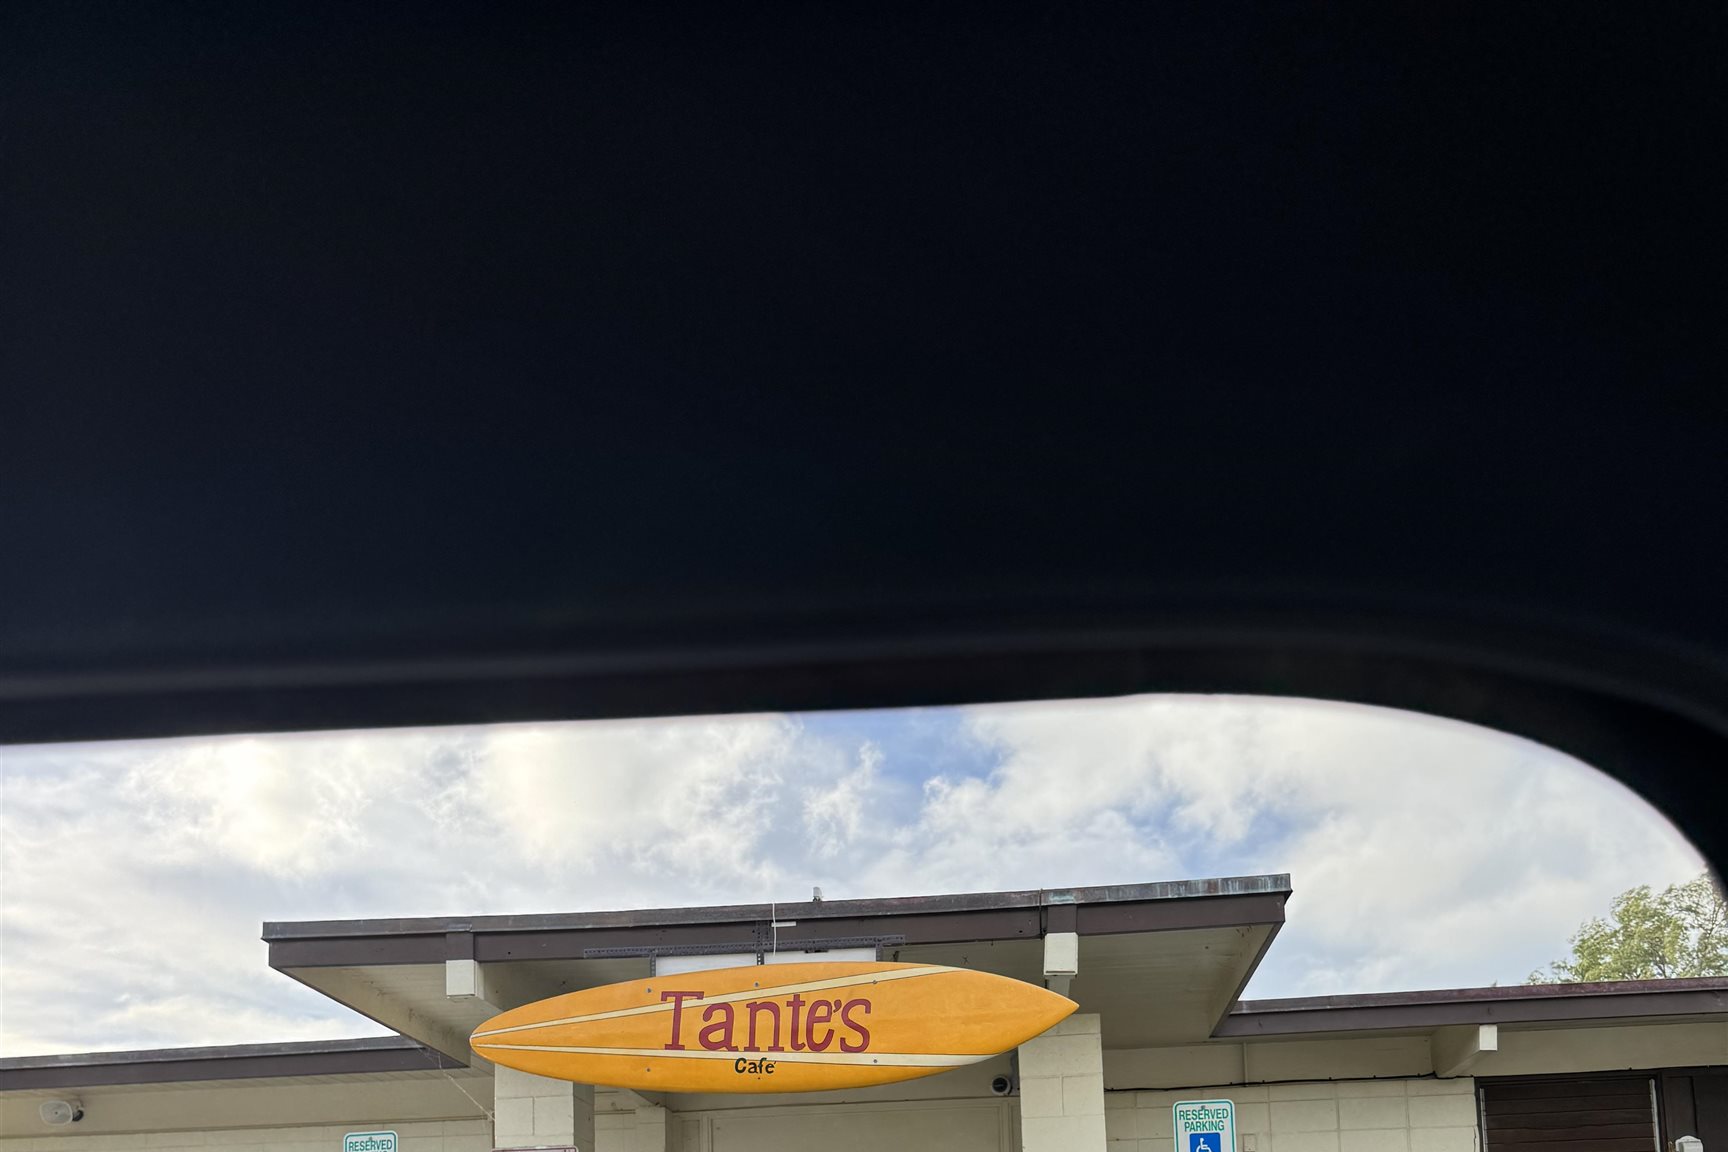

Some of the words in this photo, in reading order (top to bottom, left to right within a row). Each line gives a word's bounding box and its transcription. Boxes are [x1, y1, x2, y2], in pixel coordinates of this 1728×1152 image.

[661, 991, 872, 1053] Tante's
[1179, 1108, 1229, 1120] RESERVED
[1184, 1120, 1225, 1132] PARKING
[348, 1139, 393, 1152] RESERVED
